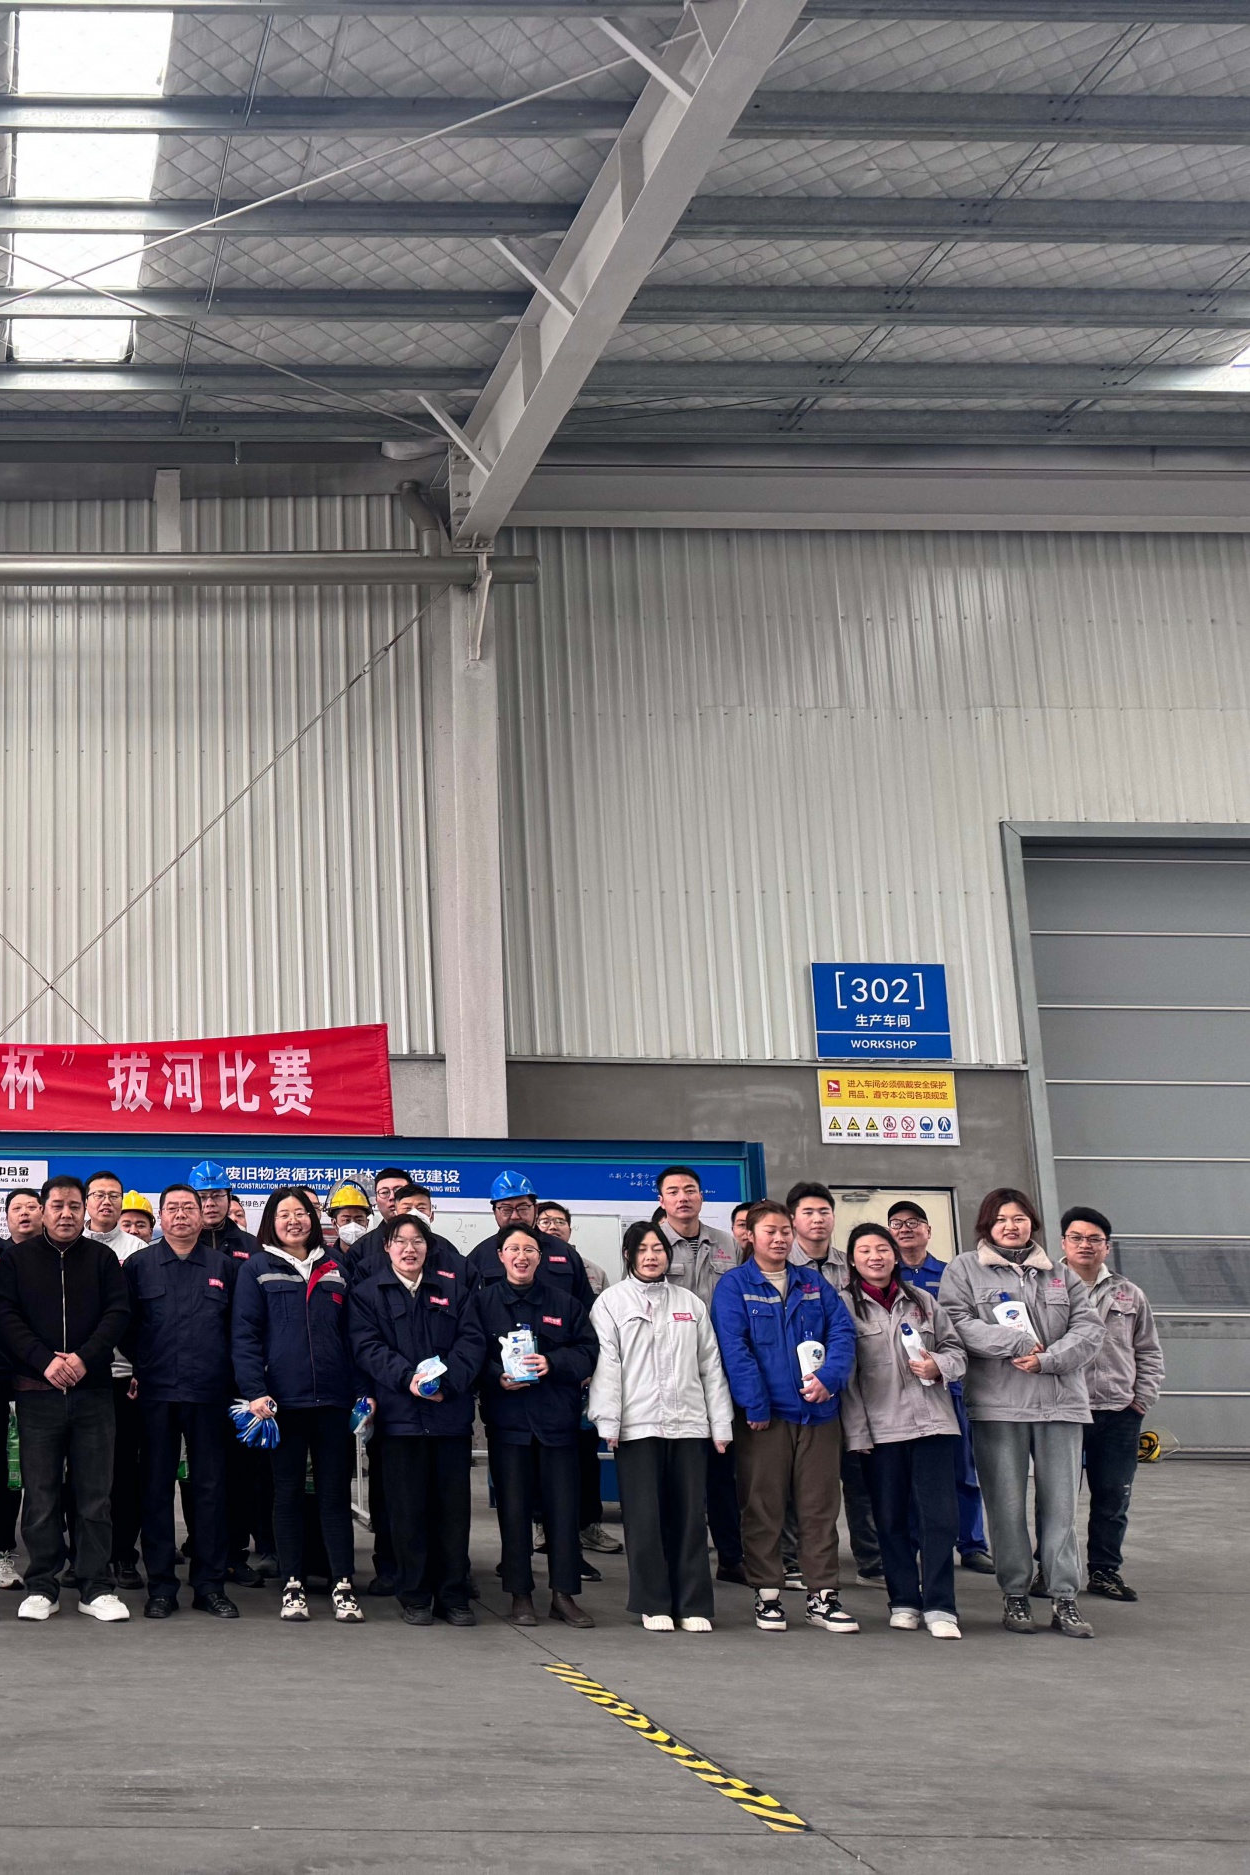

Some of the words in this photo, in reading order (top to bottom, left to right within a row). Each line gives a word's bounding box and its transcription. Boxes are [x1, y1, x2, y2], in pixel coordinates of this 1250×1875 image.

[855, 1014, 911, 1028] 生产车间
[851, 1040, 917, 1050] WORKSHOP
[847, 1079, 947, 1090] 进入车间必须佩戴安全保护
[236, 1182, 279, 1190] CONSTRUCTION
